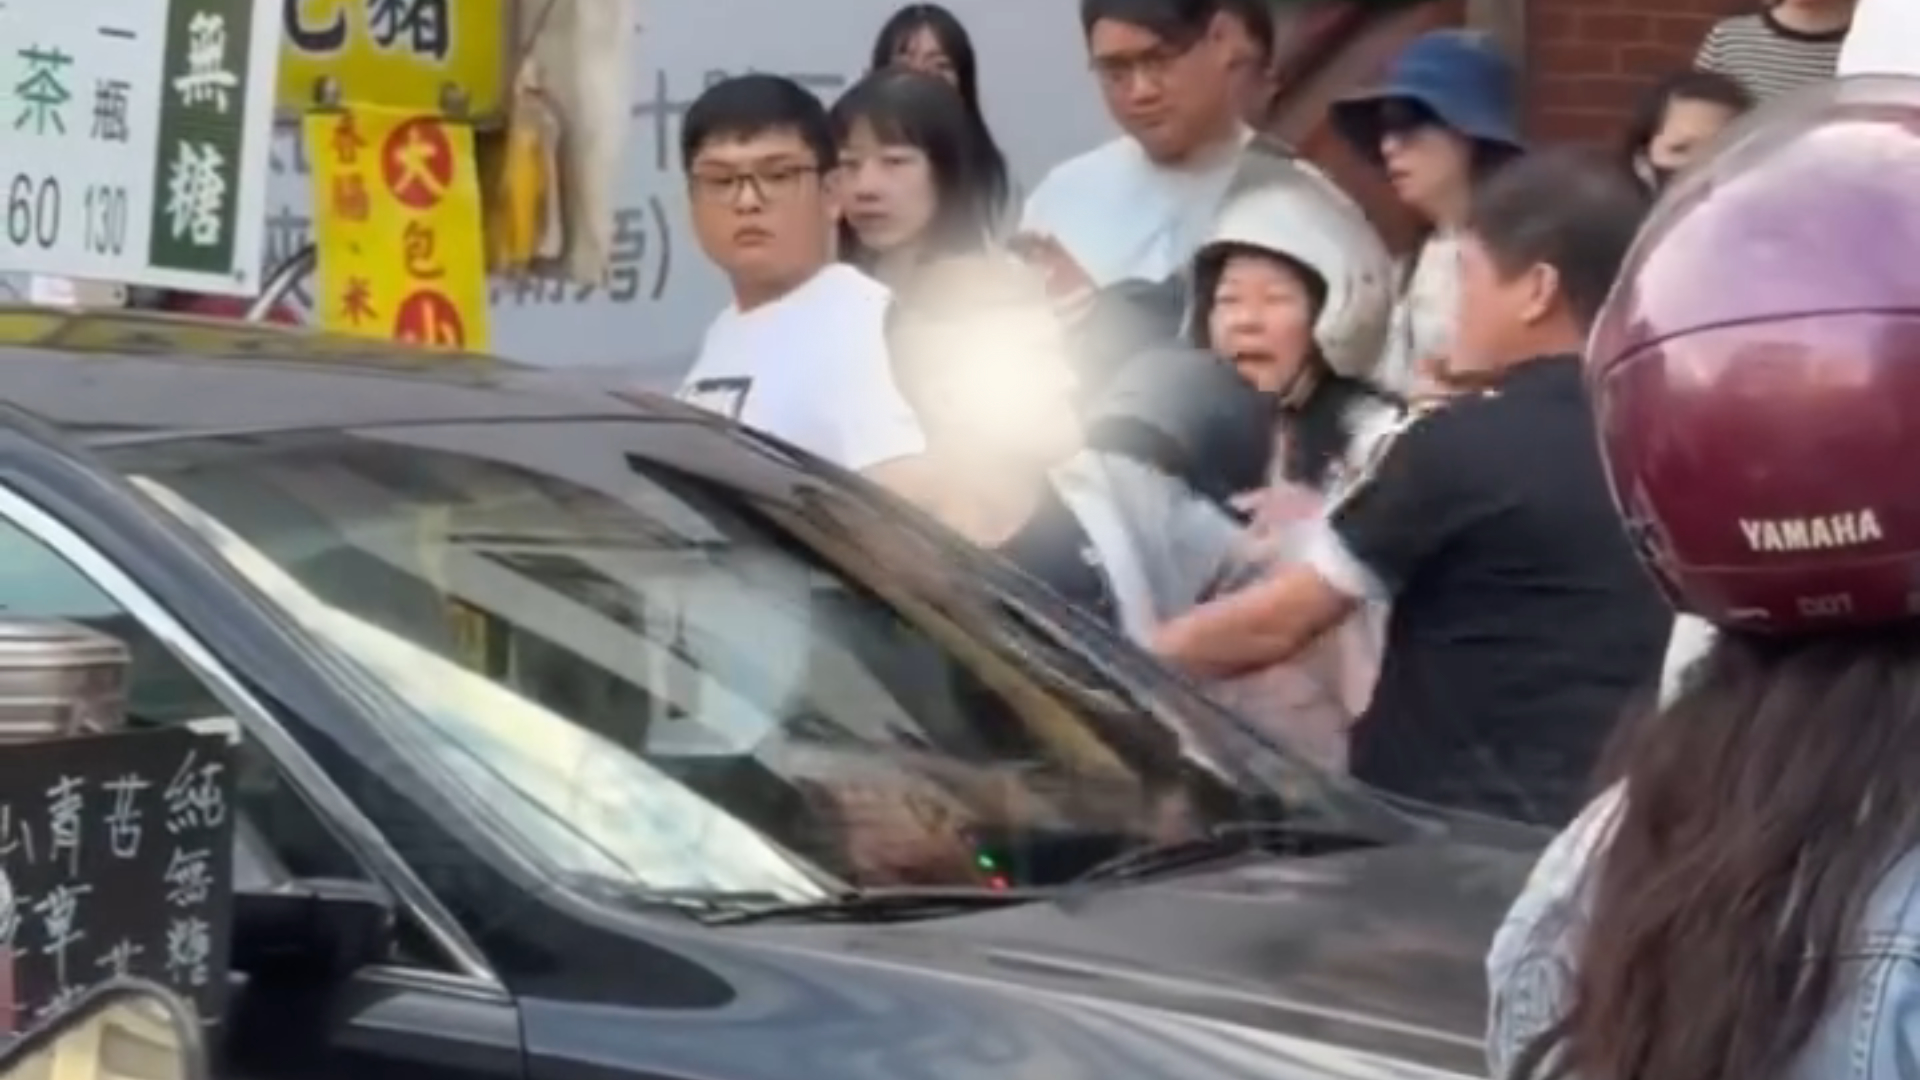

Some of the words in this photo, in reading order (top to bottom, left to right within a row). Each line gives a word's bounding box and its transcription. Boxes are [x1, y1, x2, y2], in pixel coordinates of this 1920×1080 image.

[14, 42, 74, 136] 茶
[166, 10, 239, 246] 無糖
[7, 172, 61, 250] 60
[1738, 507, 1883, 551] YAMAHA
